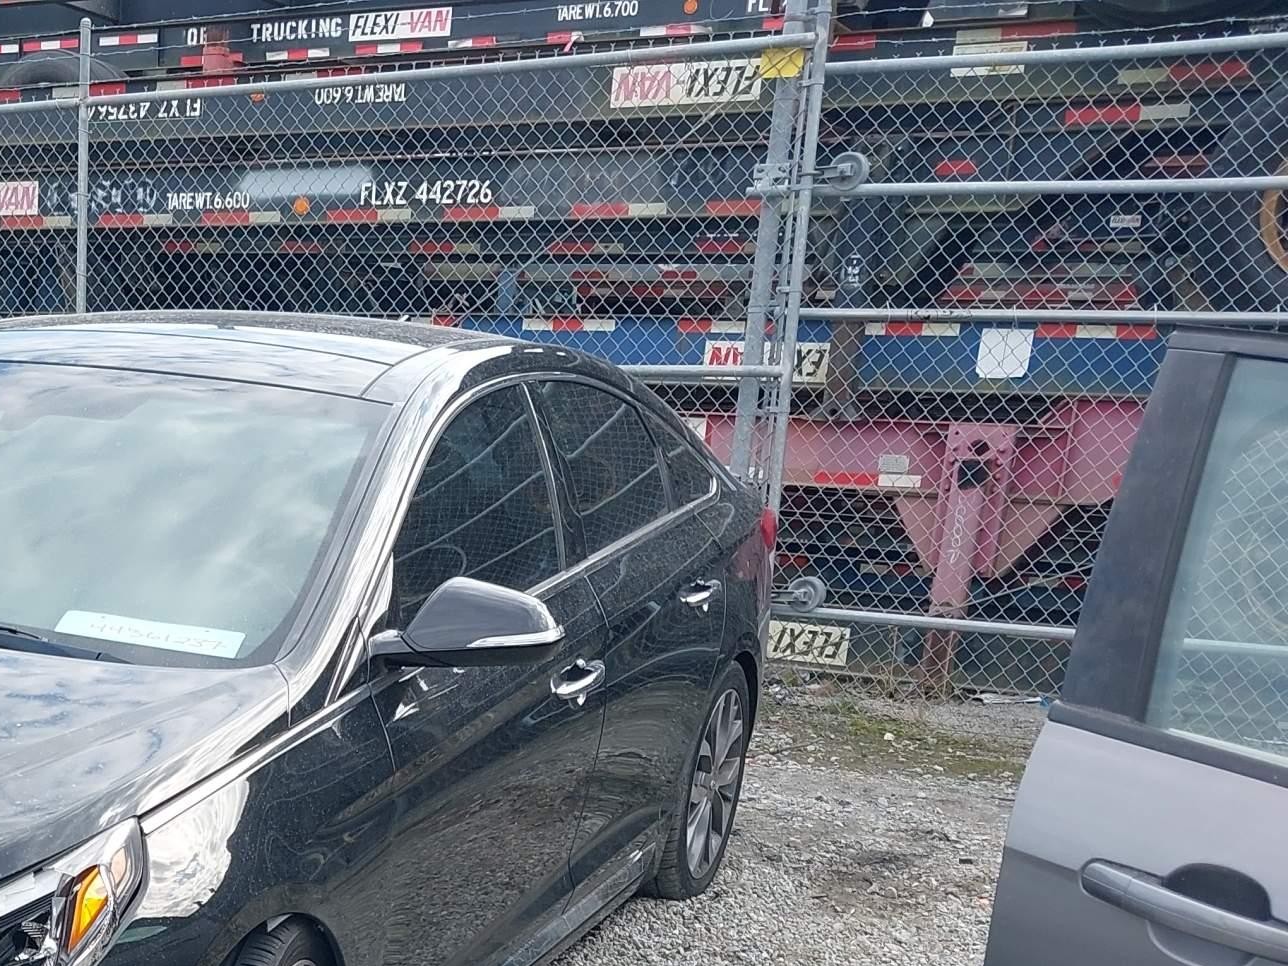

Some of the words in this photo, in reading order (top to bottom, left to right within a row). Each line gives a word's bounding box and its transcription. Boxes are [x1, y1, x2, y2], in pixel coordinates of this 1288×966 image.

[251, 17, 343, 42] TRUCKING
[352, 10, 450, 37] FLEXI-VAN
[614, 64, 760, 101] FLEXI-VAN
[360, 182, 409, 206] FLXZ
[415, 180, 493, 204] 442726
